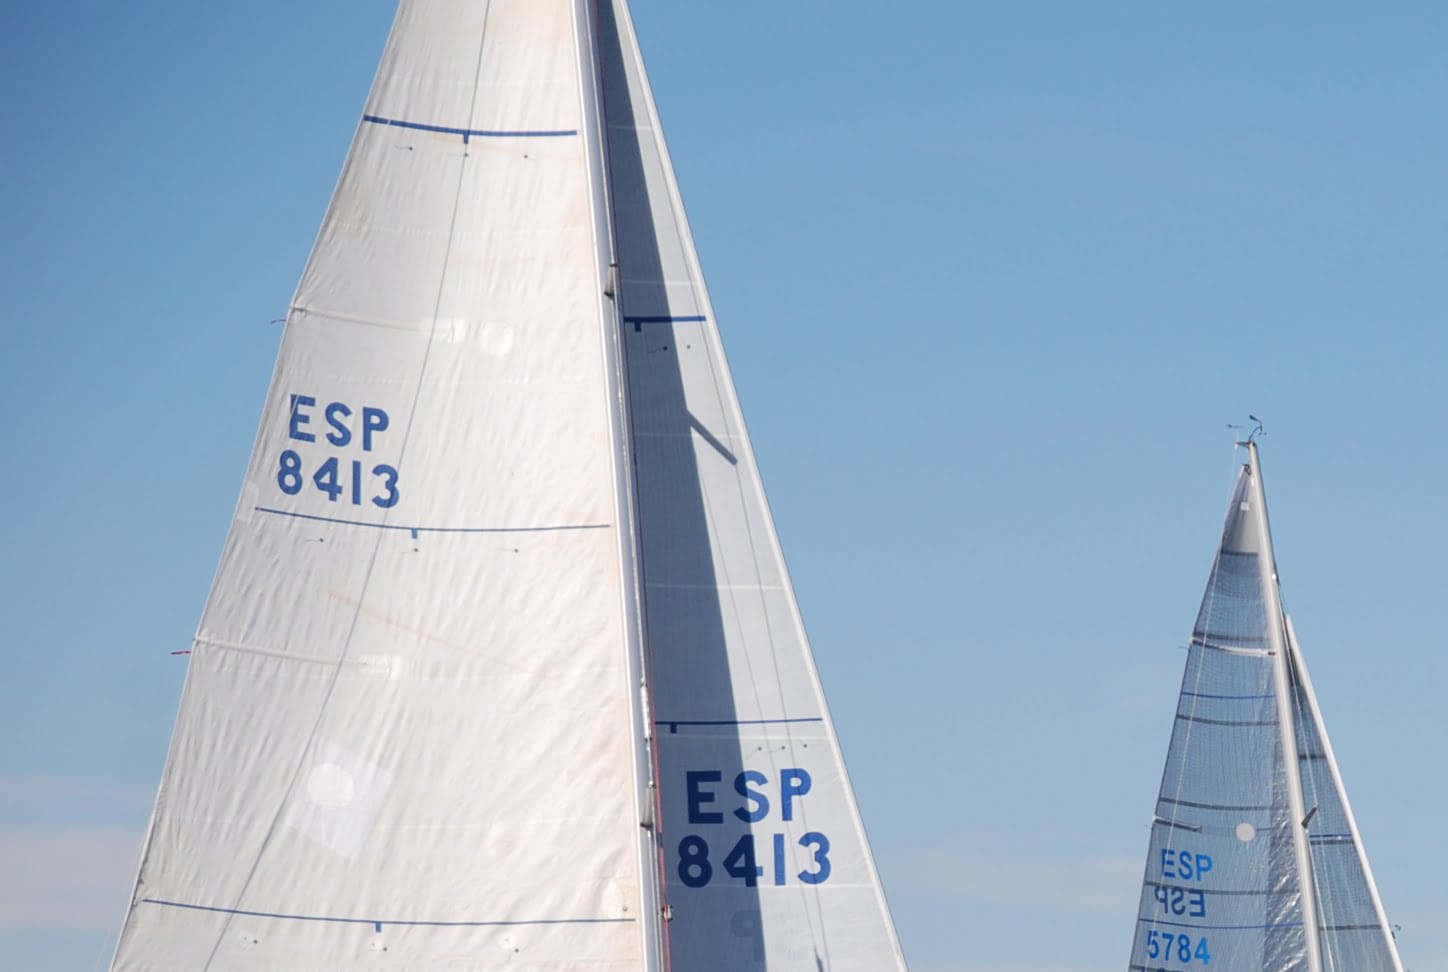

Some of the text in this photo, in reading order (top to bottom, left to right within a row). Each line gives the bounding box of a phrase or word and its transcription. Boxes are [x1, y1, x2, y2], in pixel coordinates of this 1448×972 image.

[289, 393, 389, 451] ESP
[277, 449, 400, 508] 8413
[686, 768, 812, 824] ESP
[678, 832, 831, 888] 8413
[1161, 848, 1214, 881] ESP
[1147, 930, 1212, 965] 5784
